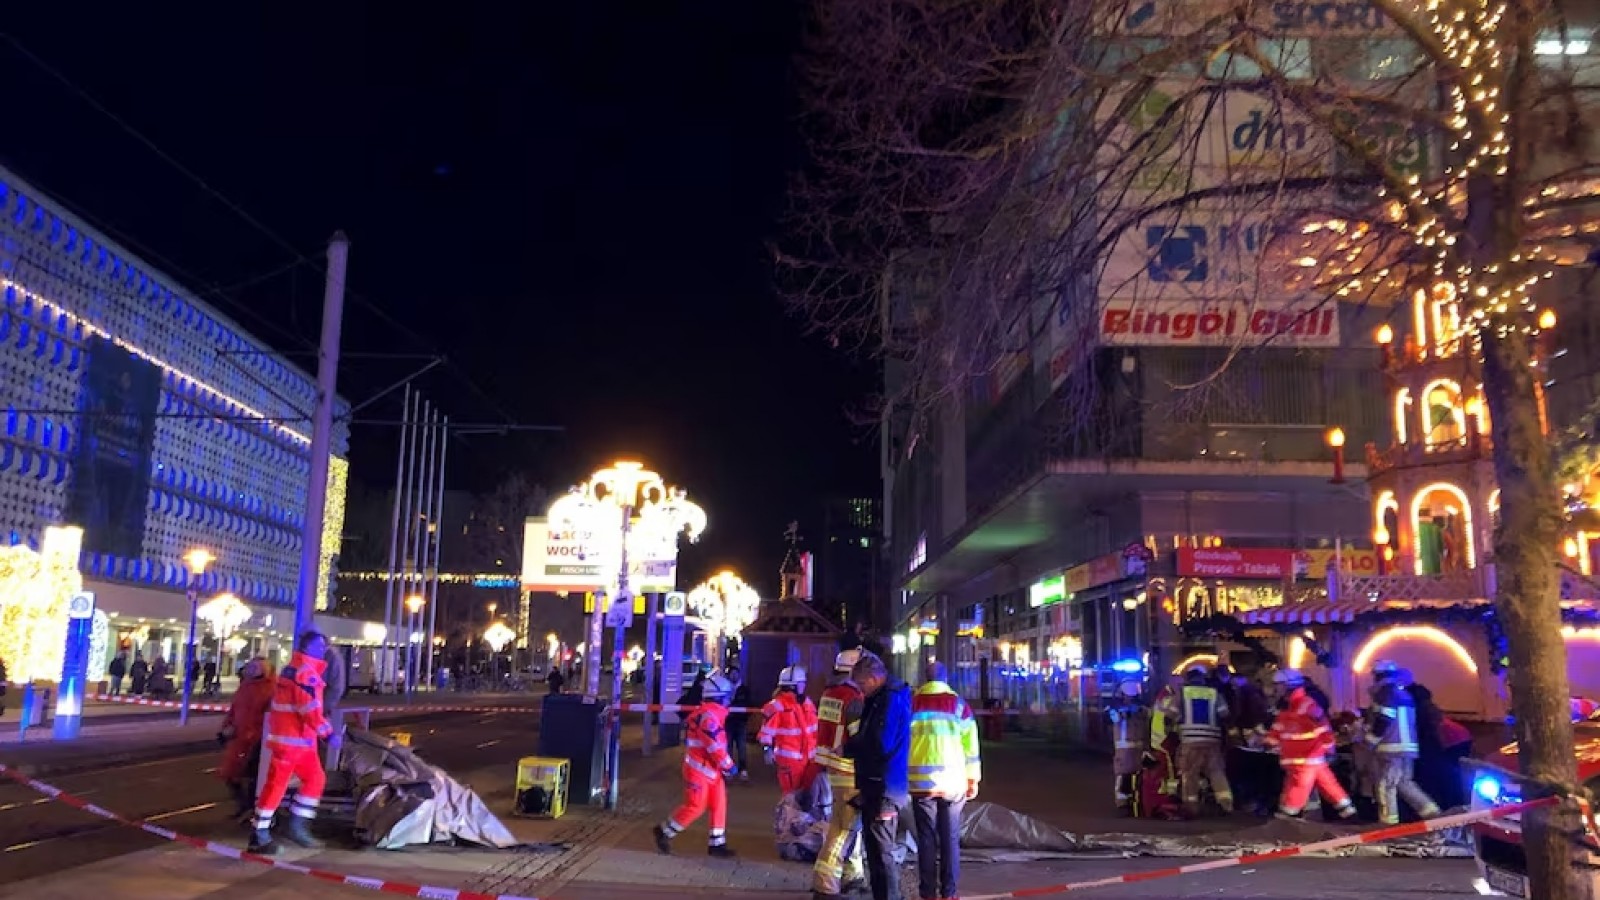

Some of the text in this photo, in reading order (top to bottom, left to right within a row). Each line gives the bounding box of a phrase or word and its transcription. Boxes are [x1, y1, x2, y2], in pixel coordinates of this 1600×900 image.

[1233, 111, 1307, 151] dm
[1103, 308, 1335, 339] Bingöl Grill
